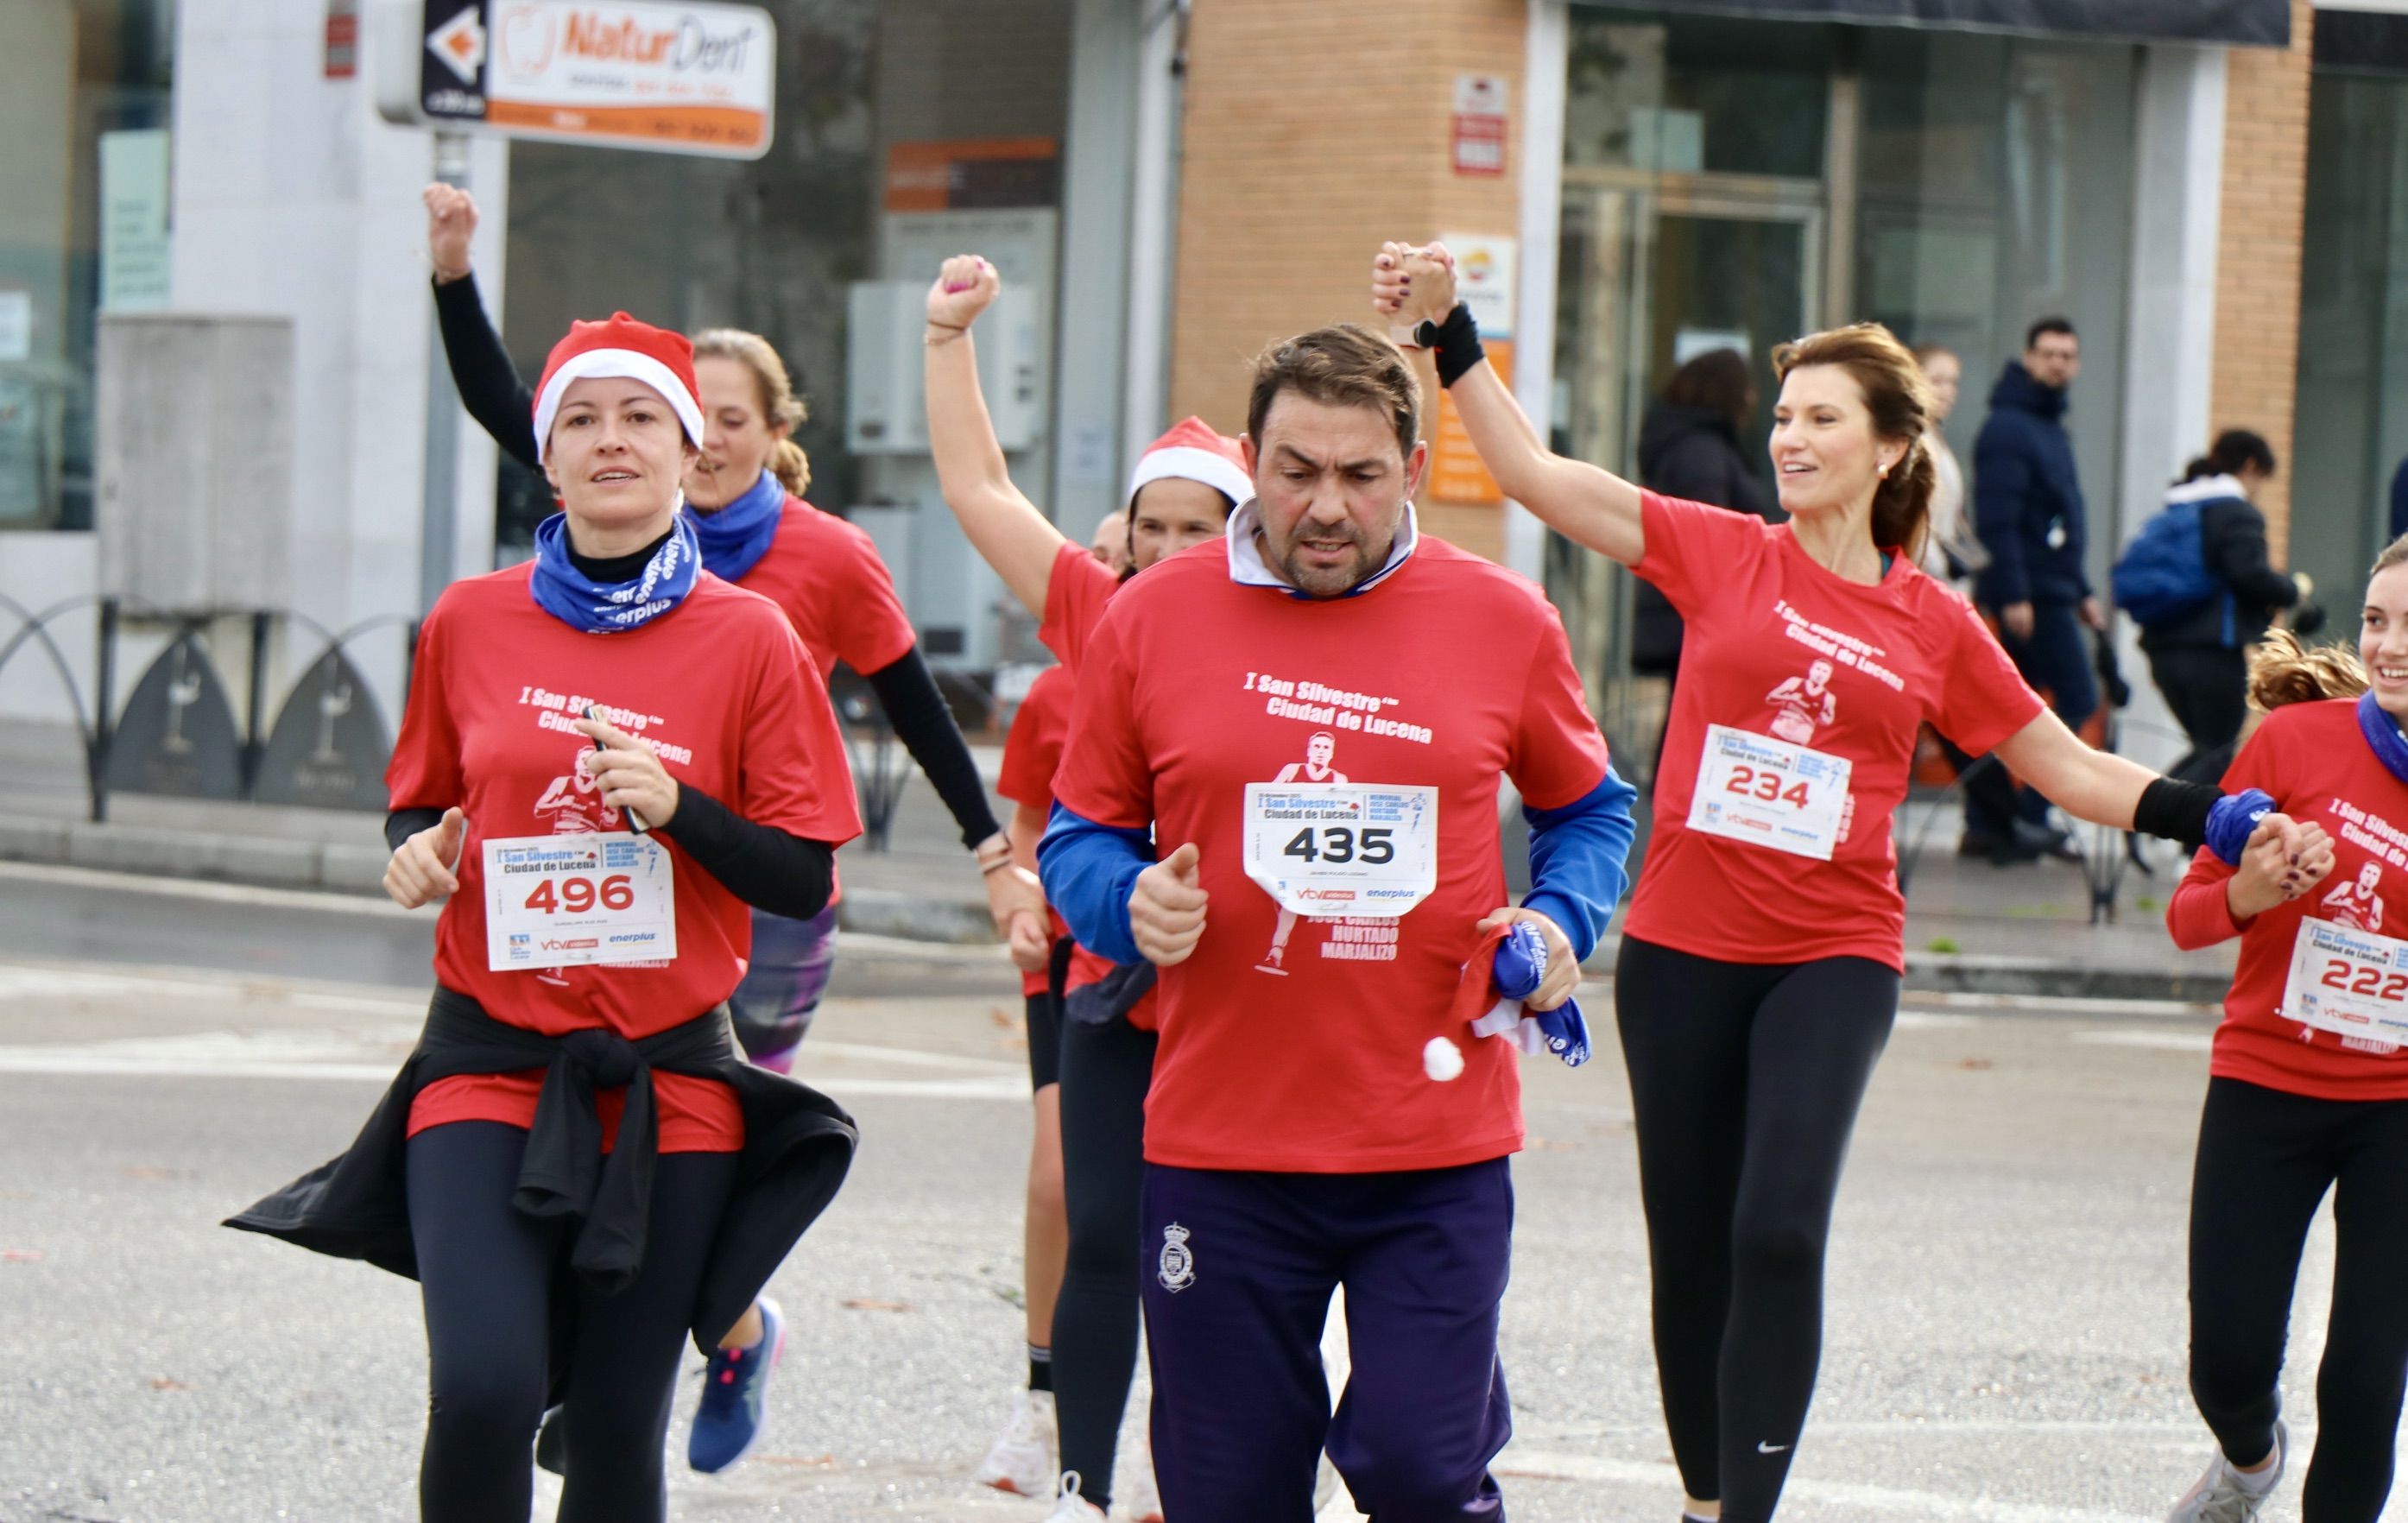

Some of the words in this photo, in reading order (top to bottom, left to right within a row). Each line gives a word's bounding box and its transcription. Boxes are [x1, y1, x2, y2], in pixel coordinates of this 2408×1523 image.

[563, 9, 752, 75] NaturDent
[1785, 623, 1838, 657] Ciudad
[1836, 648, 1857, 666] de
[1856, 656, 1905, 692] Lucena
[518, 686, 532, 705] I
[532, 688, 567, 711] San
[567, 694, 647, 730] Silestre
[1243, 672, 1257, 690] I
[1257, 674, 1294, 697] San
[1296, 681, 1381, 712] Silvestre
[1266, 697, 1336, 725] Ciudad
[1336, 711, 1362, 730] de
[1363, 715, 1432, 744] Lucena
[1266, 798, 1286, 807] San
[1288, 798, 1336, 808] Silvestre
[1726, 765, 1809, 810] 234
[1265, 809, 1302, 819] Ciudad
[1305, 809, 1318, 818] de
[1320, 810, 1358, 819] Lucena
[2328, 798, 2342, 813] I
[2338, 802, 2367, 825] San
[504, 852, 524, 863] San
[527, 850, 573, 862] Silvestre
[1284, 827, 1394, 863] 435
[2341, 821, 2390, 857] Ciudad
[2386, 848, 2406, 867] de
[504, 863, 541, 874] Ciudad
[543, 862, 557, 872] de
[559, 861, 596, 870] Lucena
[525, 875, 634, 914] 496
[1367, 888, 1415, 899] enerplus
[610, 932, 656, 943] enerplus
[1321, 942, 1398, 961] MARJALIZO
[1332, 926, 1400, 944] HURTADO
[2321, 959, 2408, 1002] 222
